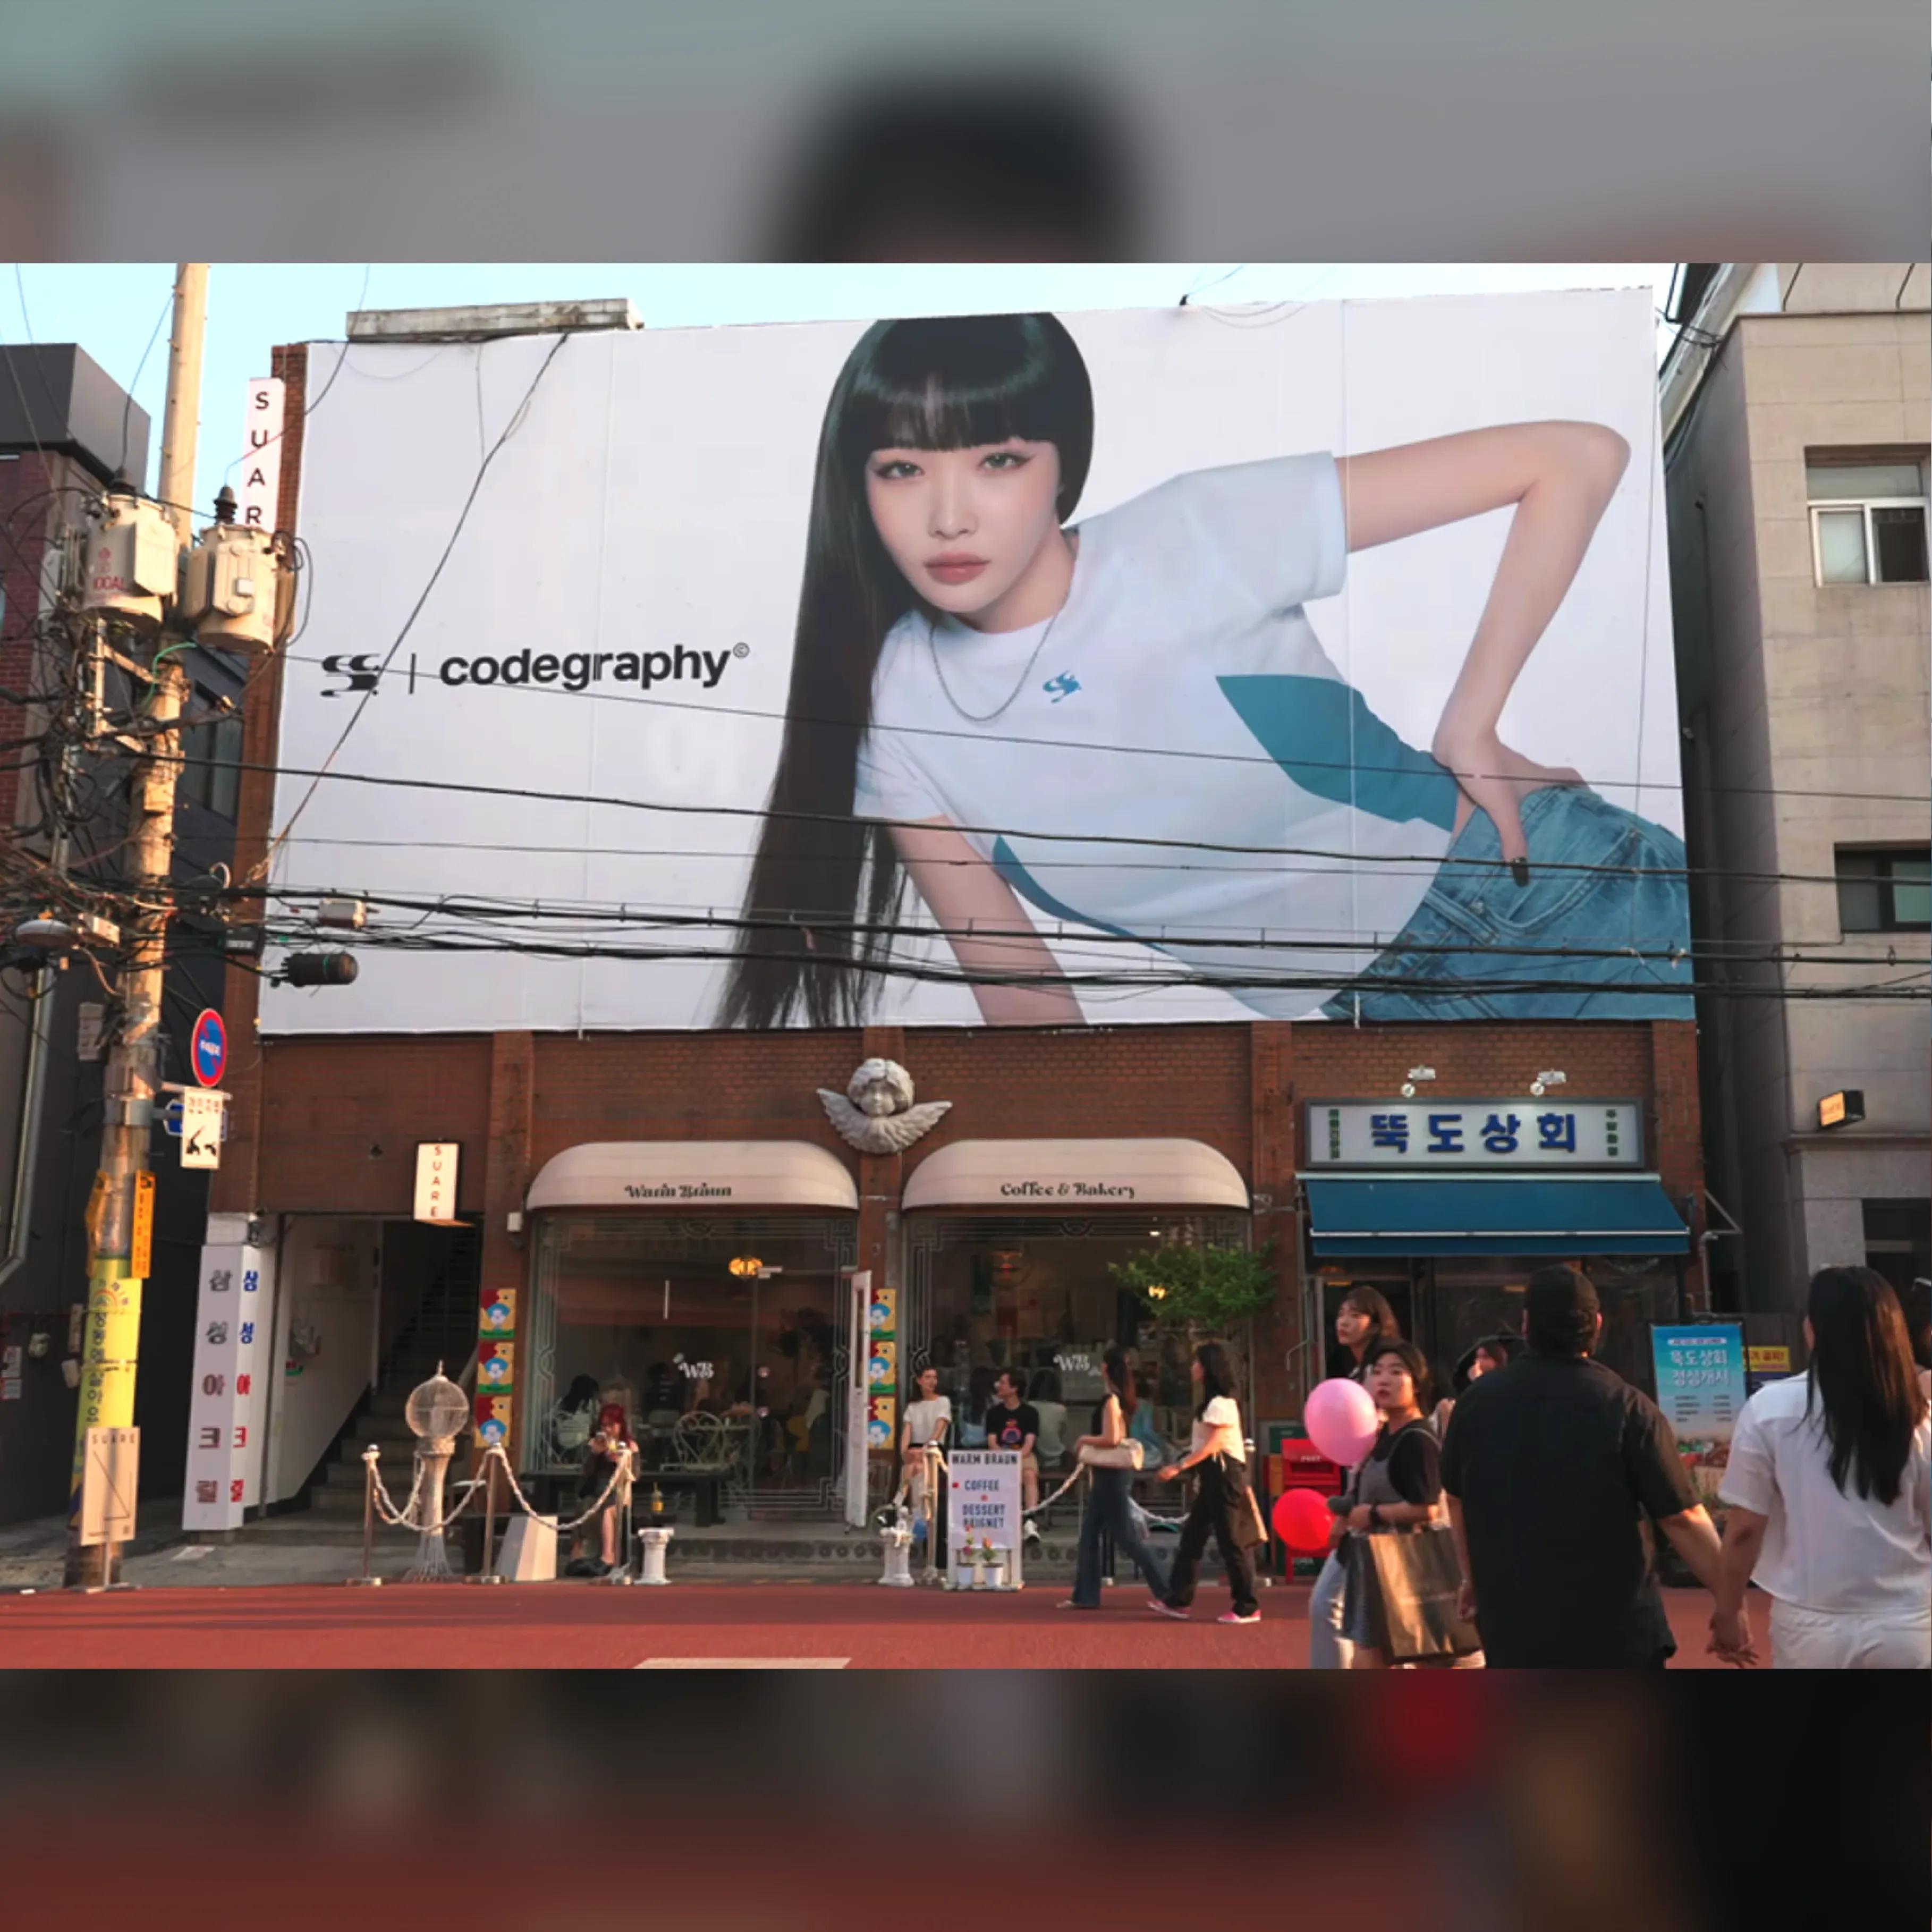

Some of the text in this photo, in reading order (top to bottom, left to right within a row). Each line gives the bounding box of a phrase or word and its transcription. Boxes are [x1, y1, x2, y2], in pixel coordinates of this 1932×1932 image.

[1371, 1113, 1577, 1154] 뚝도상회
[430, 1145, 442, 1217] SUARE
[1000, 1181, 1134, 1199] Coffee & Bakery
[953, 1454, 980, 1464] WARM
[965, 1480, 999, 1491] COFFEE
[963, 1504, 1005, 1515] DESSERT
